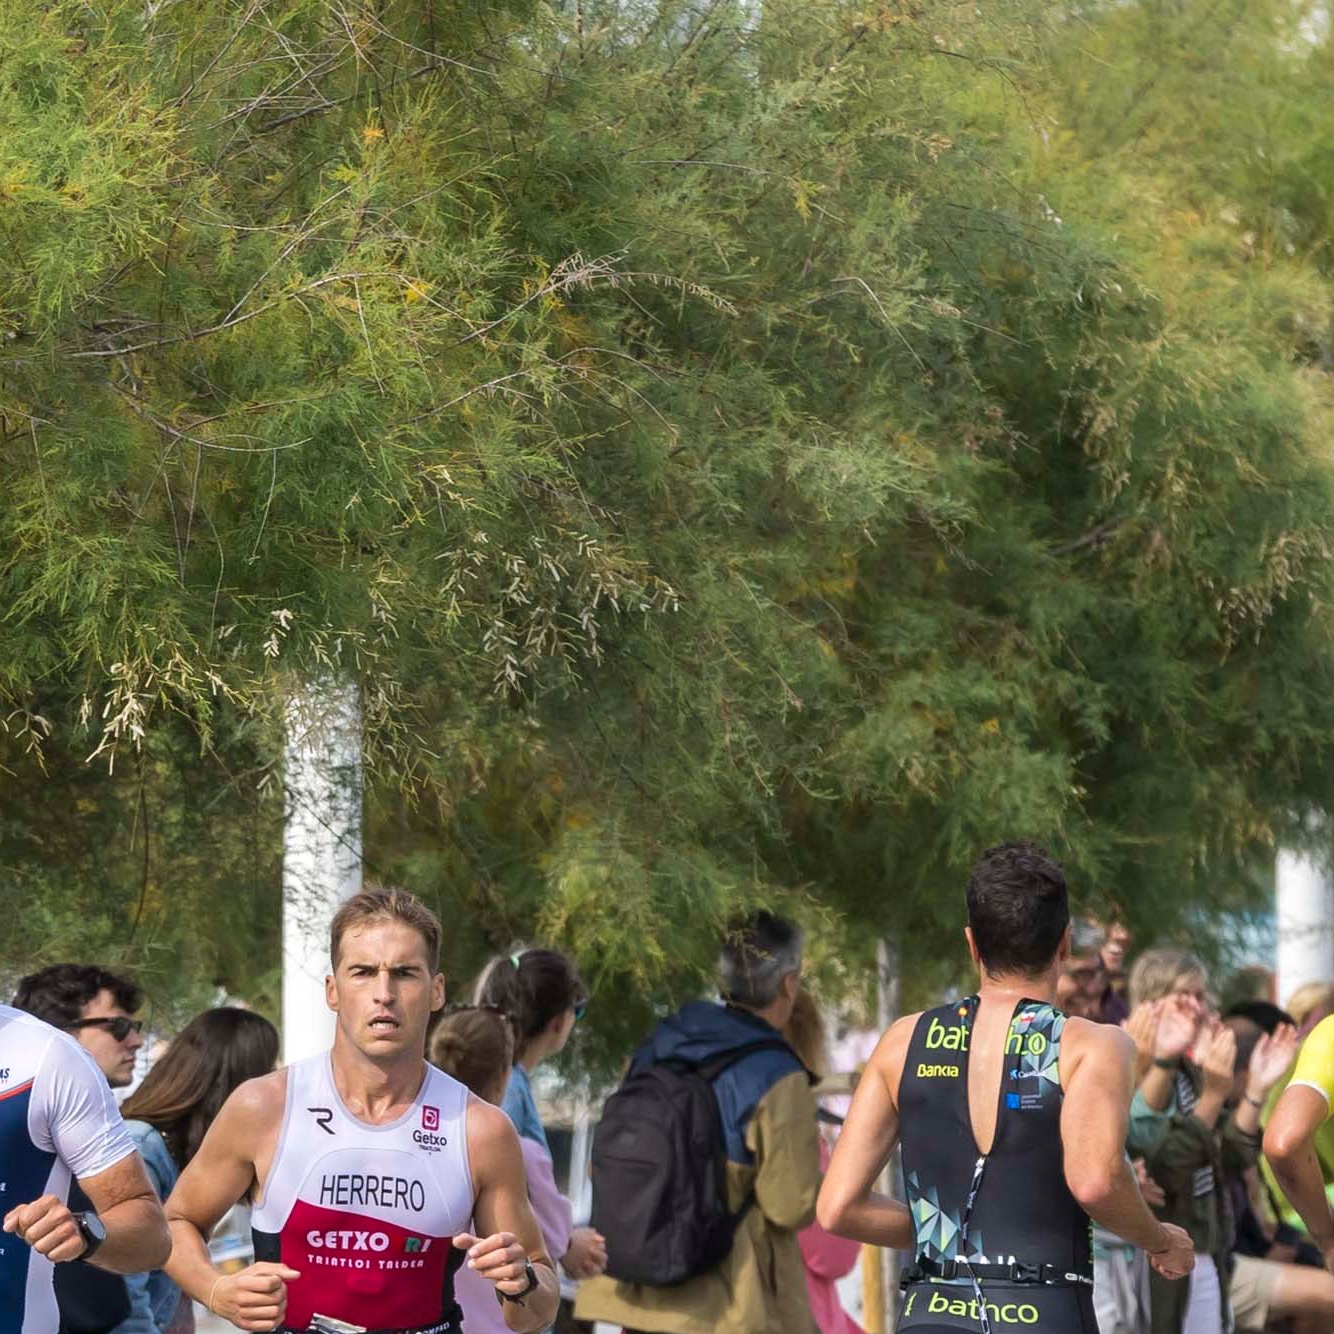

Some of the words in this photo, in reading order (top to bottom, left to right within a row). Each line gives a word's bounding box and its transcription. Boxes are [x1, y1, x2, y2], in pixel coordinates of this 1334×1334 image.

[412, 1130, 447, 1146] Getxo
[319, 1174, 425, 1211] HERRERO
[307, 1230, 389, 1252] GETXO
[308, 1254, 370, 1269] TRIATLOI
[379, 1259, 424, 1269] TALDEA
